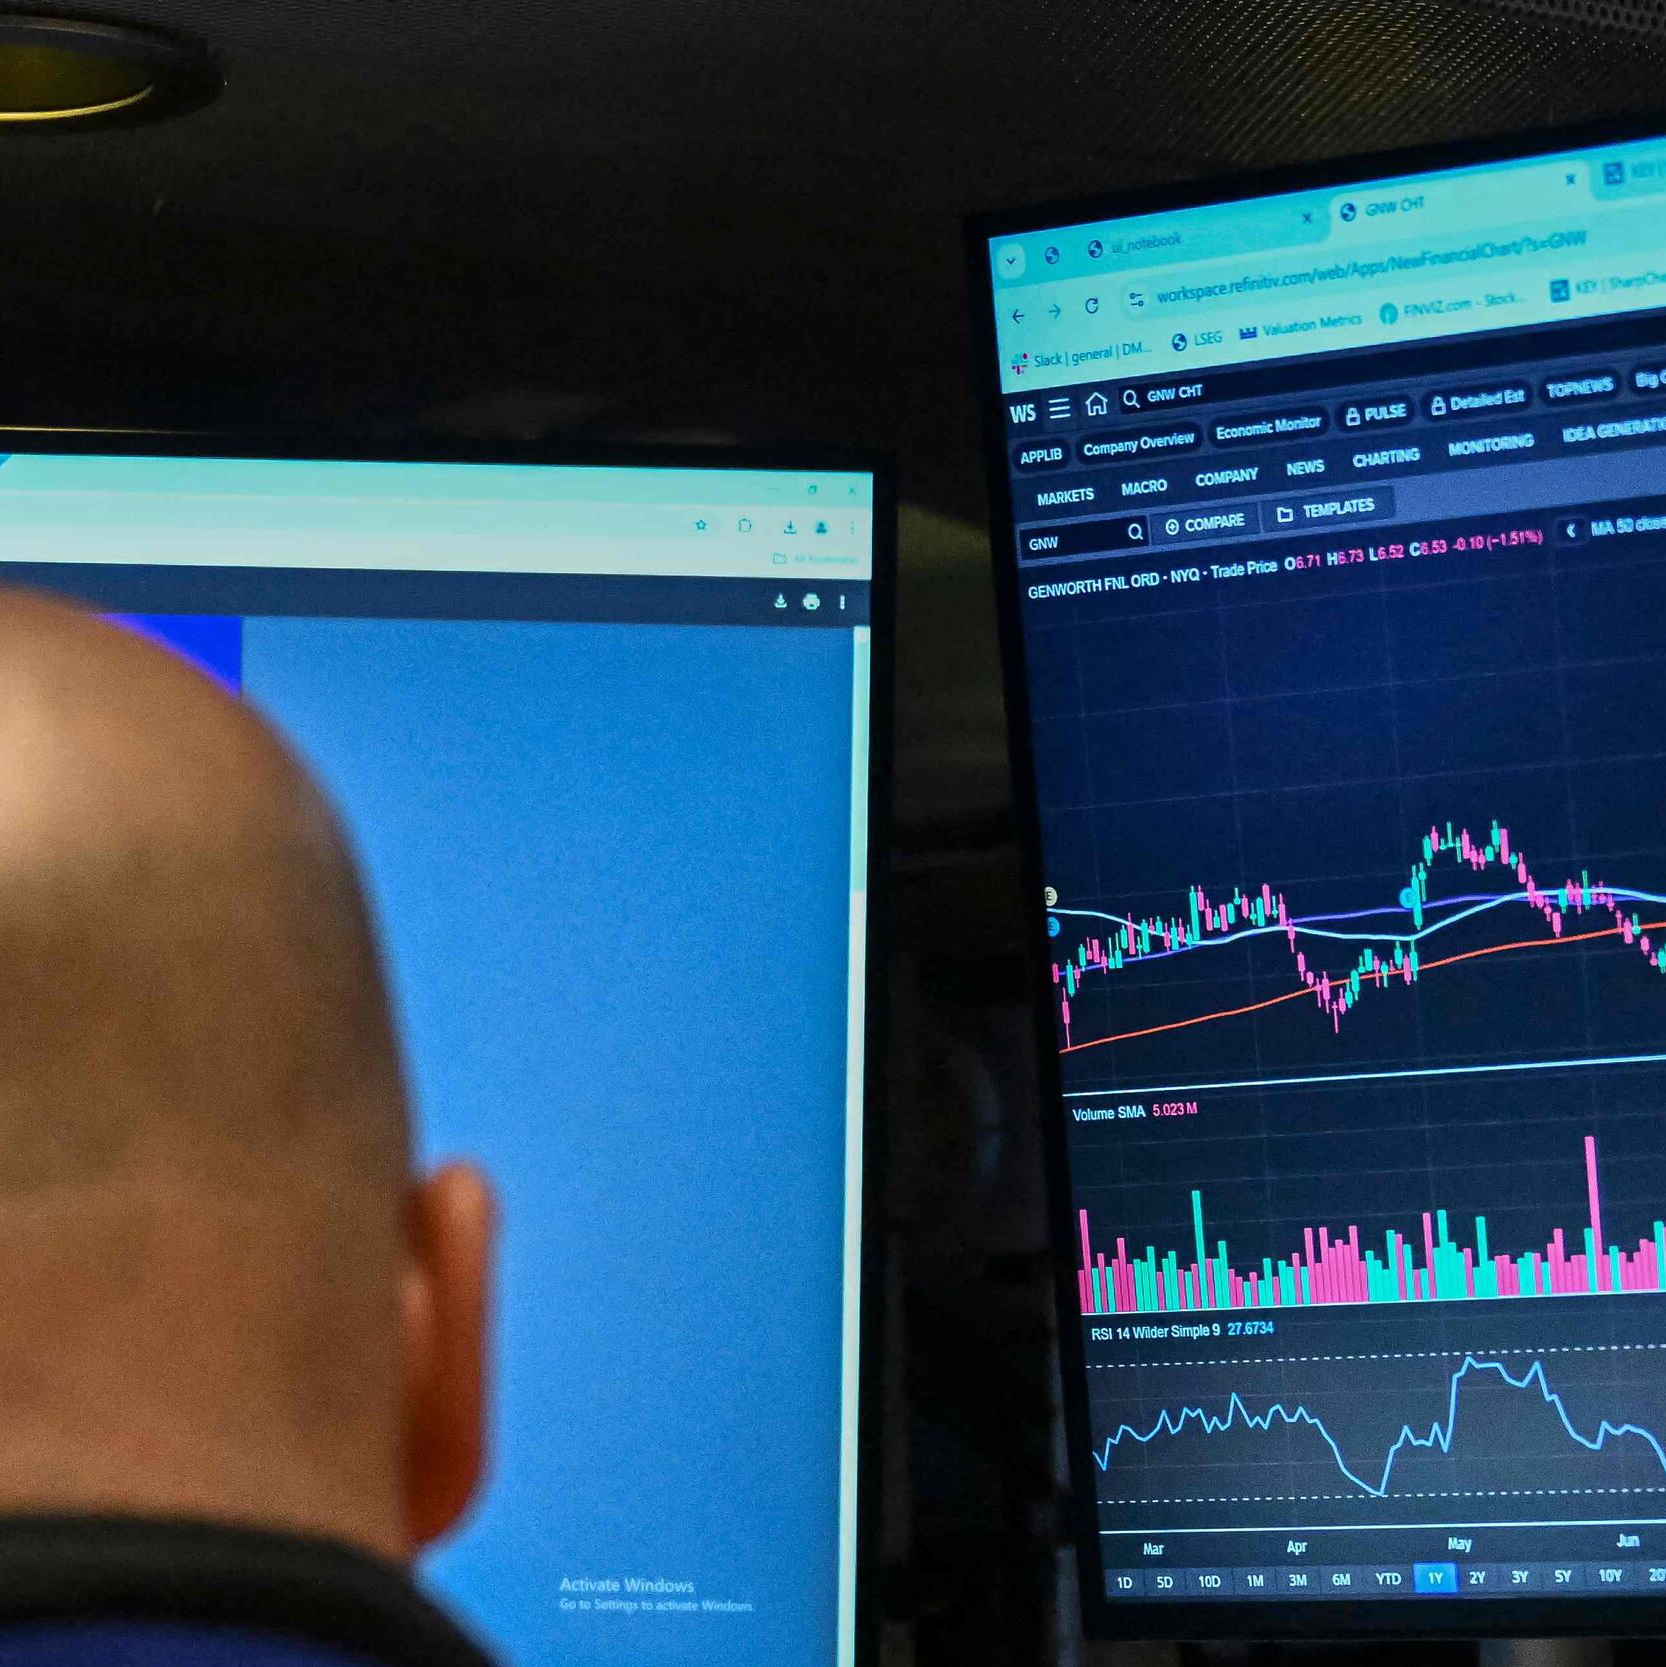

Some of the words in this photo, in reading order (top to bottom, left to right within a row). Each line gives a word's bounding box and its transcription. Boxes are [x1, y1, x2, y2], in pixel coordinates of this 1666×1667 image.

[1263, 319, 1317, 338] Valuation
[1320, 313, 1362, 331] Metrics
[1194, 331, 1222, 346] LSEG
[1035, 353, 1062, 368] Slack
[1072, 347, 1114, 364] general
[1148, 389, 1175, 402] GNW
[1179, 384, 1203, 398] CHT
[1010, 404, 1036, 423] WS
[1365, 404, 1407, 421] PULSE
[1217, 424, 1273, 440] Economic
[1276, 416, 1321, 432] Monitor
[1084, 440, 1137, 456] Company
[1140, 432, 1194, 449] Overview
[1449, 434, 1534, 456] MONITORING
[1021, 448, 1062, 464] APPLIB
[1353, 449, 1420, 468] CHARTING
[1196, 468, 1258, 486] COMPANY
[1287, 460, 1325, 476] NEWS
[1038, 488, 1094, 506] MARKETS
[1122, 479, 1167, 496] MACRO
[1304, 498, 1375, 519] TEMPLATES
[1185, 513, 1244, 532] COMPARE
[1030, 537, 1058, 551] GNW
[1029, 579, 1102, 598] GENWORTH
[1105, 576, 1129, 590] FNL
[1131, 573, 1159, 587] ORD
[1171, 568, 1200, 584] NYQ
[1212, 564, 1245, 579] Trade
[1247, 559, 1277, 574] Price
[1073, 1108, 1114, 1121] Volume
[1118, 1105, 1146, 1118] SMA
[1187, 1102, 1197, 1114] M
[1091, 1328, 1112, 1340] RSI
[1117, 1327, 1130, 1339] 14
[1133, 1325, 1168, 1339] Wilder
[1171, 1325, 1210, 1340] Simple
[1212, 1324, 1220, 1336] 9
[1228, 1322, 1274, 1335] 27.6734
[1143, 1543, 1164, 1555] Mar
[1287, 1540, 1308, 1555] Apr
[1448, 1536, 1472, 1553] May
[560, 1578, 621, 1592] Activate
[625, 1578, 695, 1593] Windows
[1117, 1577, 1132, 1589] 1D
[1157, 1576, 1173, 1588] 5D
[1199, 1576, 1221, 1588] 10D
[1247, 1575, 1264, 1587] 1M
[1289, 1574, 1307, 1586] 3M
[1332, 1574, 1350, 1585] 6M
[1375, 1573, 1401, 1585] YTD
[1469, 1571, 1486, 1583] 2Y
[1511, 1571, 1528, 1583] 3Y
[1599, 1569, 1622, 1581] 10Y
